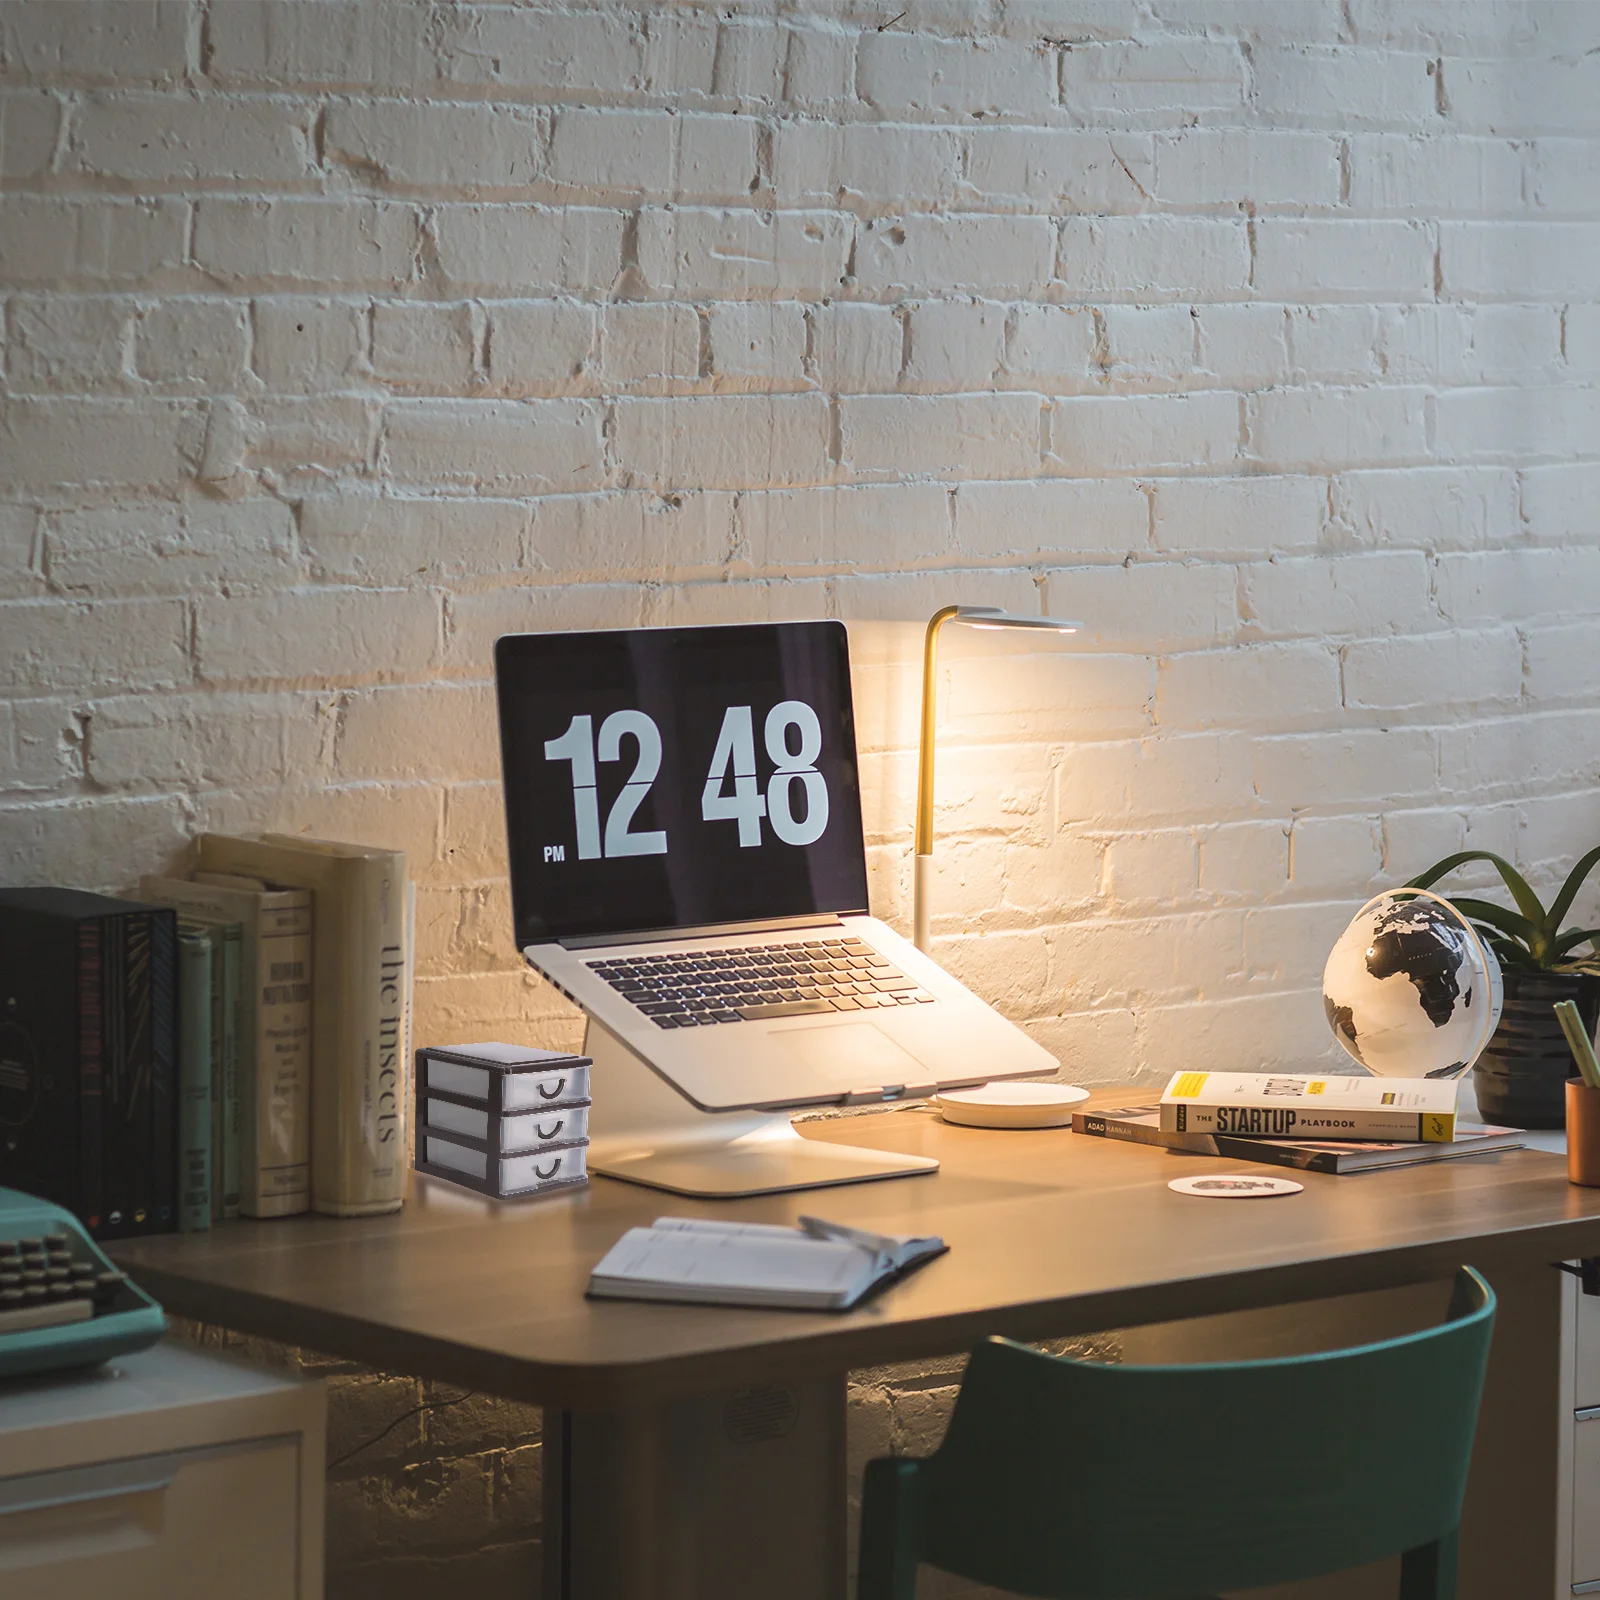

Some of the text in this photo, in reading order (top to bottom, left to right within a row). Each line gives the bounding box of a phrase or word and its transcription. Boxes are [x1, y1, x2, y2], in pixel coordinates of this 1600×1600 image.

[544, 700, 830, 860] 12 48
[543, 845, 565, 863] PM
[379, 945, 404, 1004] the
[378, 1016, 401, 1143] insects
[1087, 1122, 1105, 1132] ADAD
[1106, 1125, 1132, 1136] HANNAH
[1196, 1114, 1213, 1123] THE
[1216, 1107, 1297, 1134] STARTUP
[1300, 1118, 1356, 1129] PLAYBOOK
